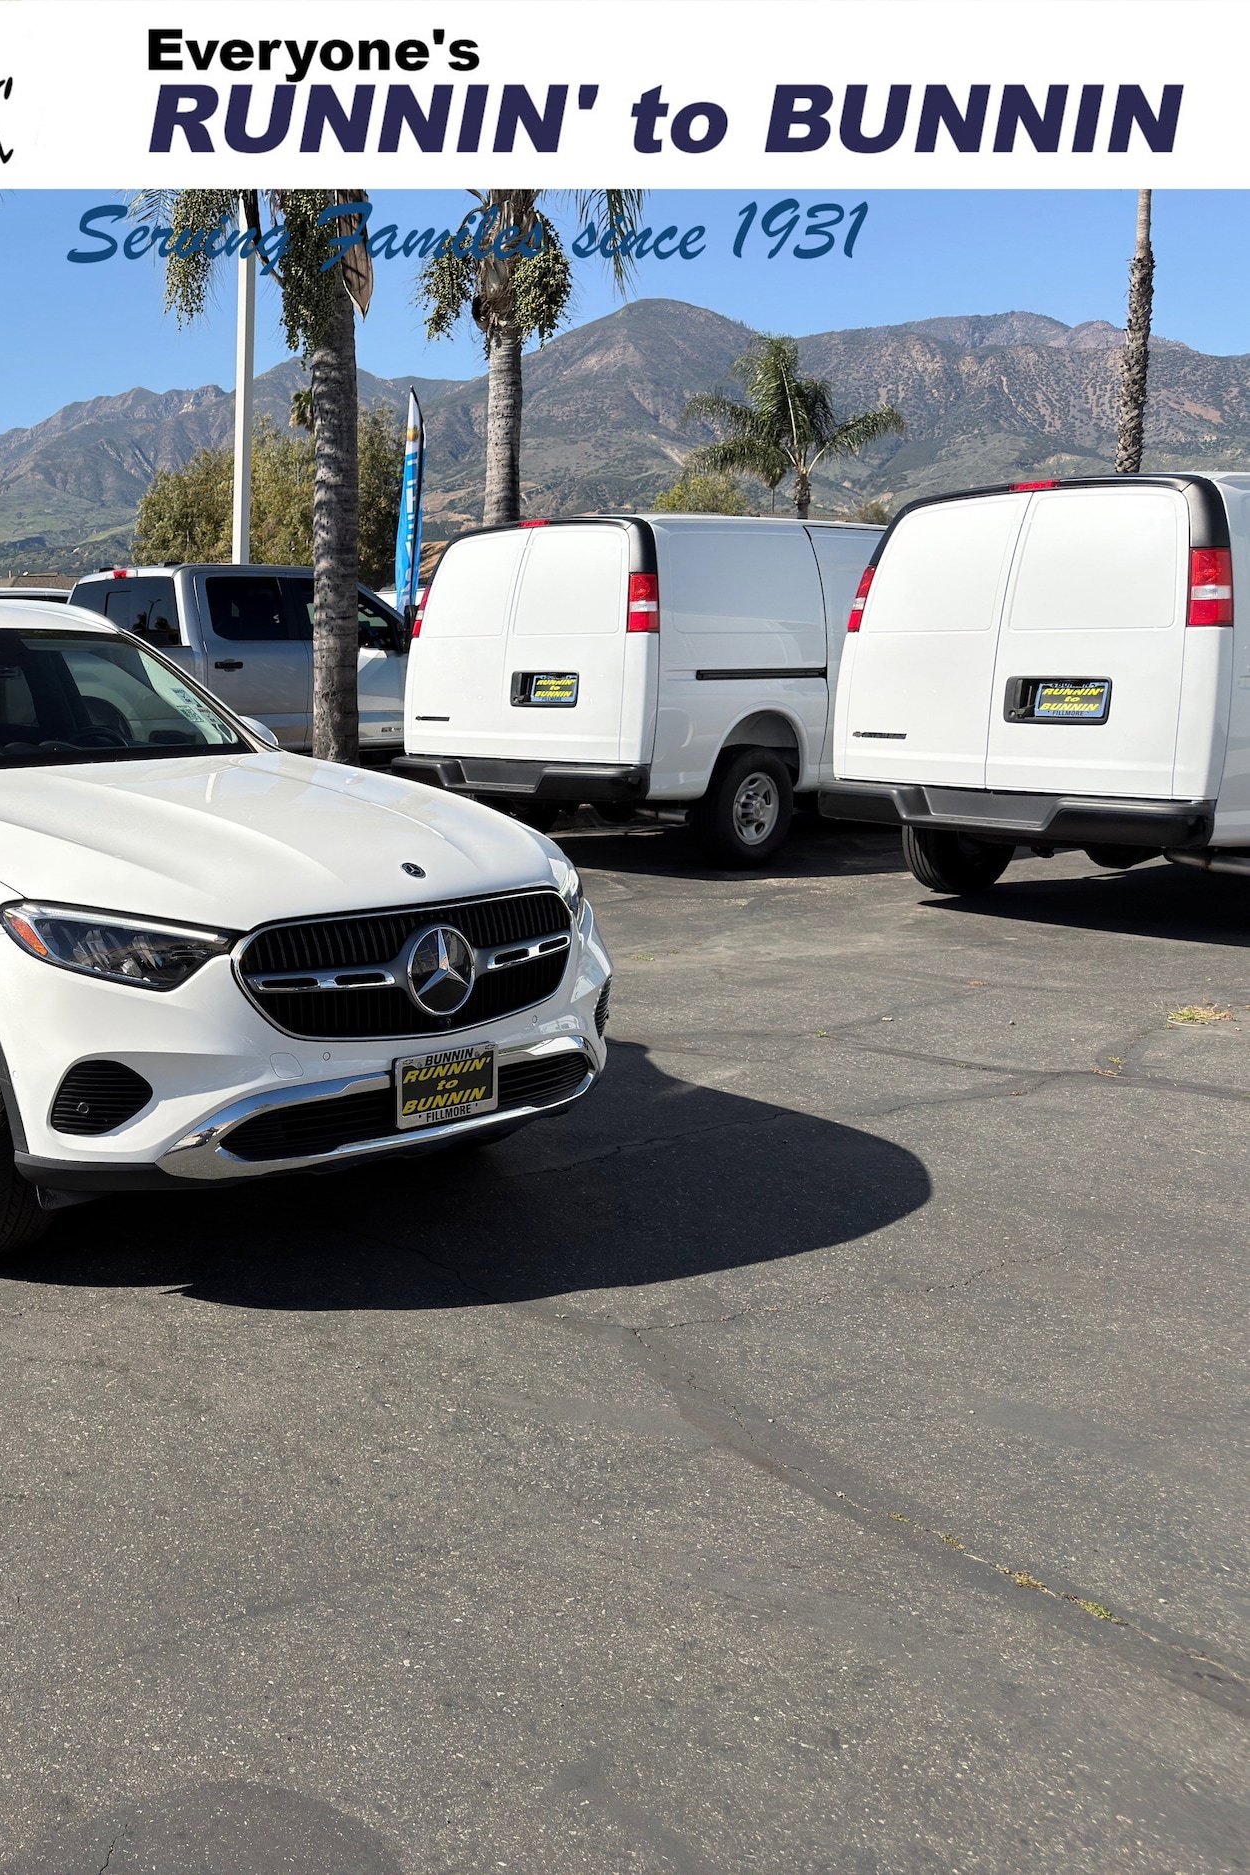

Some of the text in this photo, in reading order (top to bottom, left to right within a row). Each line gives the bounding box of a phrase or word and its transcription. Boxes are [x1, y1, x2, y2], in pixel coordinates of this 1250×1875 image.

[1042, 688, 1104, 696] RUNNIN'
[1039, 703, 1099, 711] BUNNIN
[425, 1048, 474, 1067] BUNNIN
[403, 1056, 492, 1084] RUNNIN'
[436, 1079, 458, 1091] to
[402, 1086, 486, 1114] BUNNIN
[426, 1104, 471, 1122] FILLMORE
